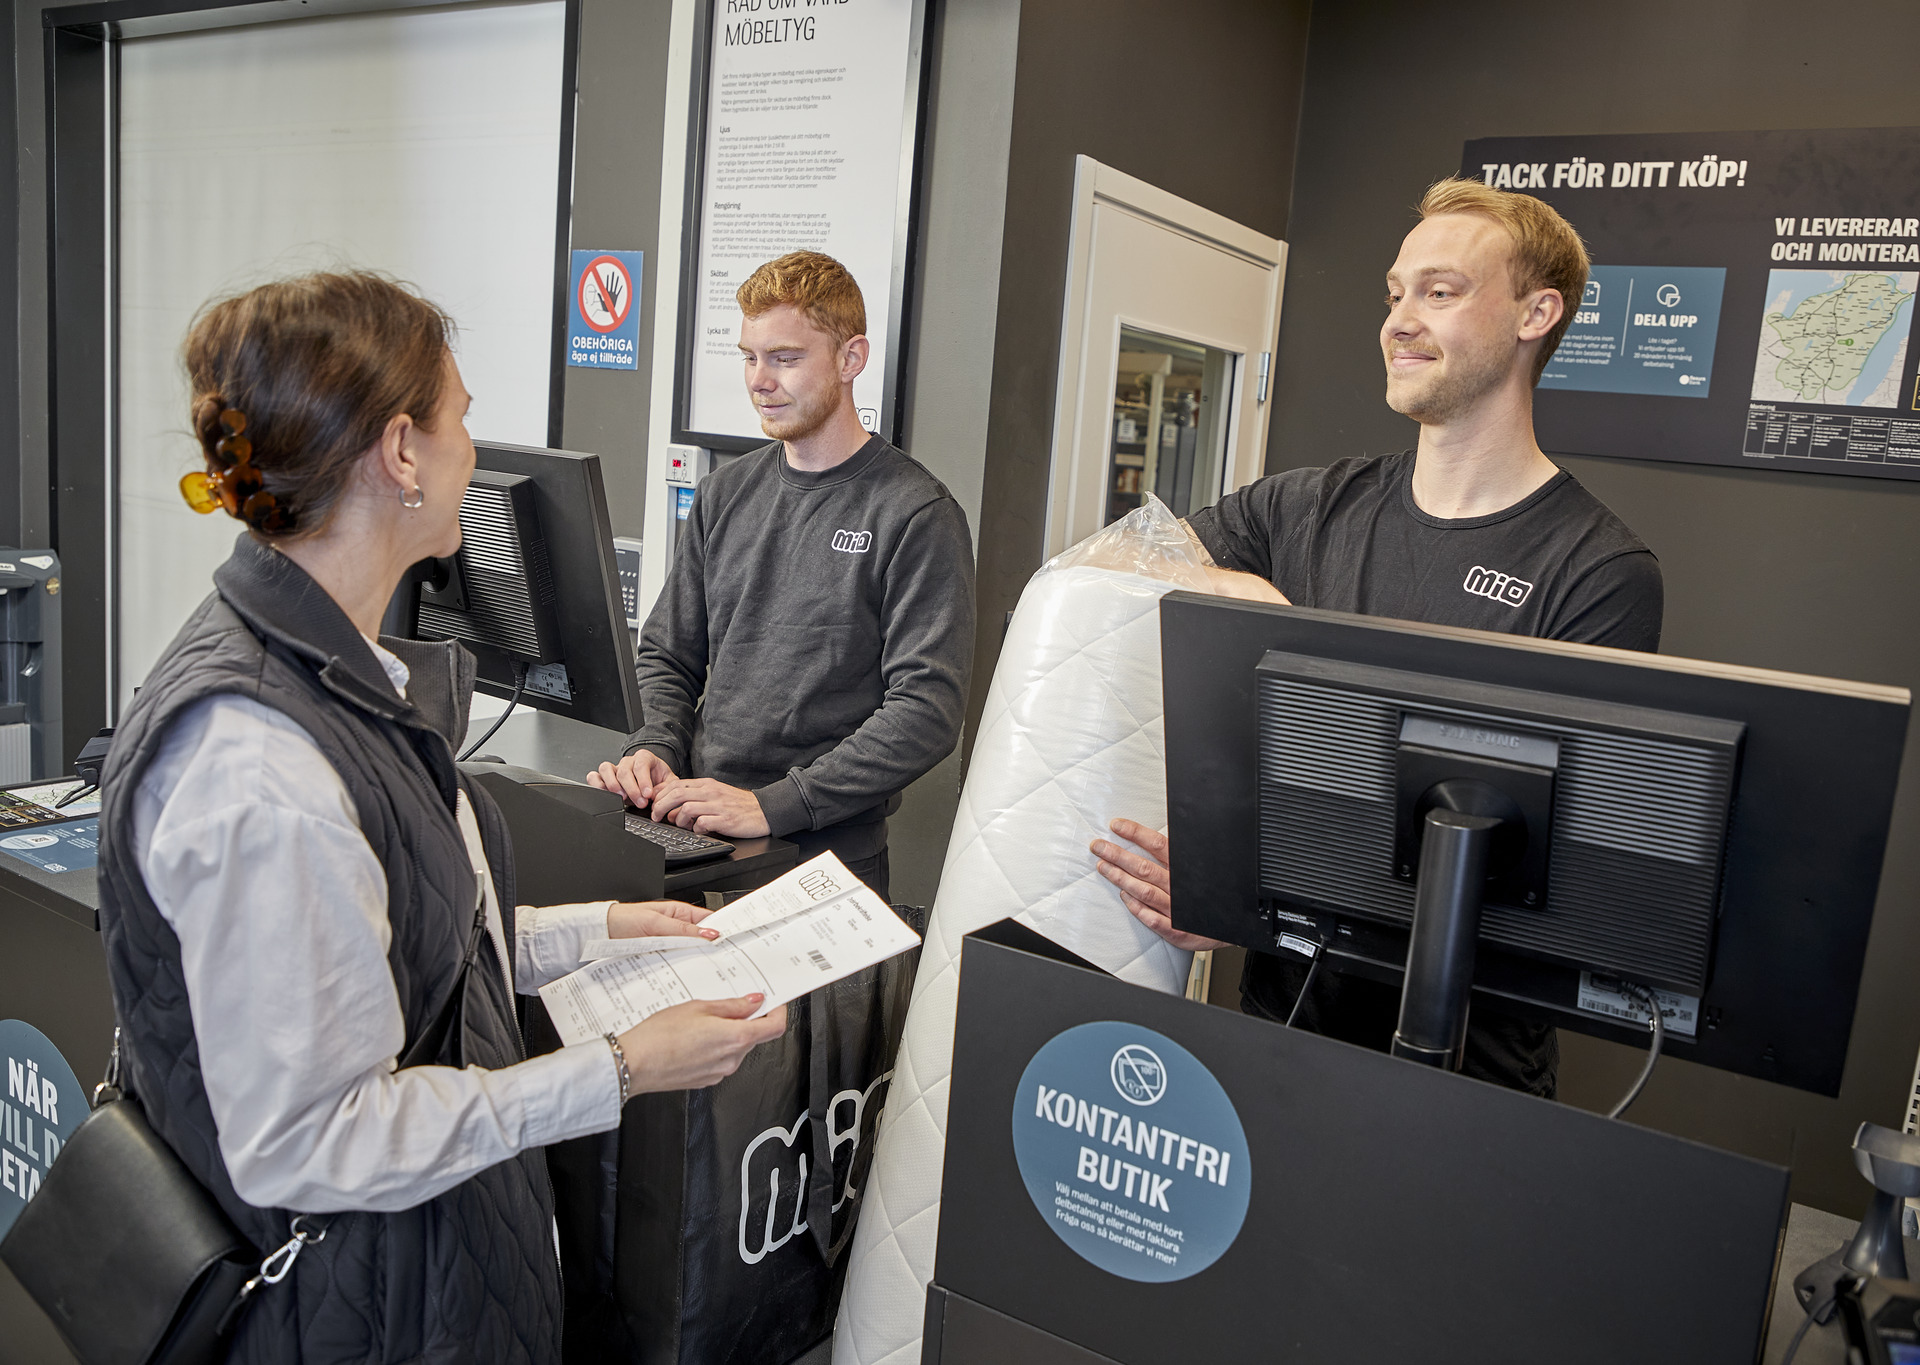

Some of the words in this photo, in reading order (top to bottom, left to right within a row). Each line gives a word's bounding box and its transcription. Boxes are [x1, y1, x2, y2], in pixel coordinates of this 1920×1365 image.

[725, 16, 815, 46] MÖBELTYG
[1482, 163, 1549, 189] TACK
[1552, 157, 1605, 189] FÖR
[1611, 161, 1674, 188] DITT
[1679, 155, 1748, 188] KÖP!
[714, 202, 741, 210] Rengöring
[1775, 217, 1795, 236] VI
[1800, 218, 1920, 237] LEVERERAR
[1771, 243, 1814, 262] OCH
[707, 327, 721, 335] Lycka
[1634, 313, 1667, 327] DELA
[1669, 315, 1698, 328] UPP
[571, 350, 588, 363] äga
[590, 351, 598, 364] ej
[599, 352, 633, 365] tillträde
[572, 335, 633, 352] OBEHÖRIGA
[8, 1056, 59, 1126] NÄR
[44, 1127, 67, 1170] D
[1035, 1084, 1231, 1187] KONTANTFRI
[1077, 1146, 1173, 1213] BUTIK
[1055, 1181, 1071, 1199] Välj
[1071, 1186, 1100, 1207] mellan
[1100, 1199, 1113, 1213] att
[1114, 1203, 1141, 1224] betala
[1143, 1213, 1162, 1231] med
[1163, 1221, 1185, 1242] kort,
[1055, 1195, 1105, 1224] delbetalning
[1106, 1215, 1124, 1231] eller
[1126, 1222, 1146, 1240] med
[1147, 1230, 1181, 1254] faktura.
[1055, 1208, 1079, 1228] Fråga
[1081, 1219, 1095, 1234] oss
[1097, 1223, 1107, 1237] så
[1108, 1229, 1145, 1252] berättar
[1146, 1242, 1154, 1256] vi
[1155, 1247, 1177, 1267] mer!
